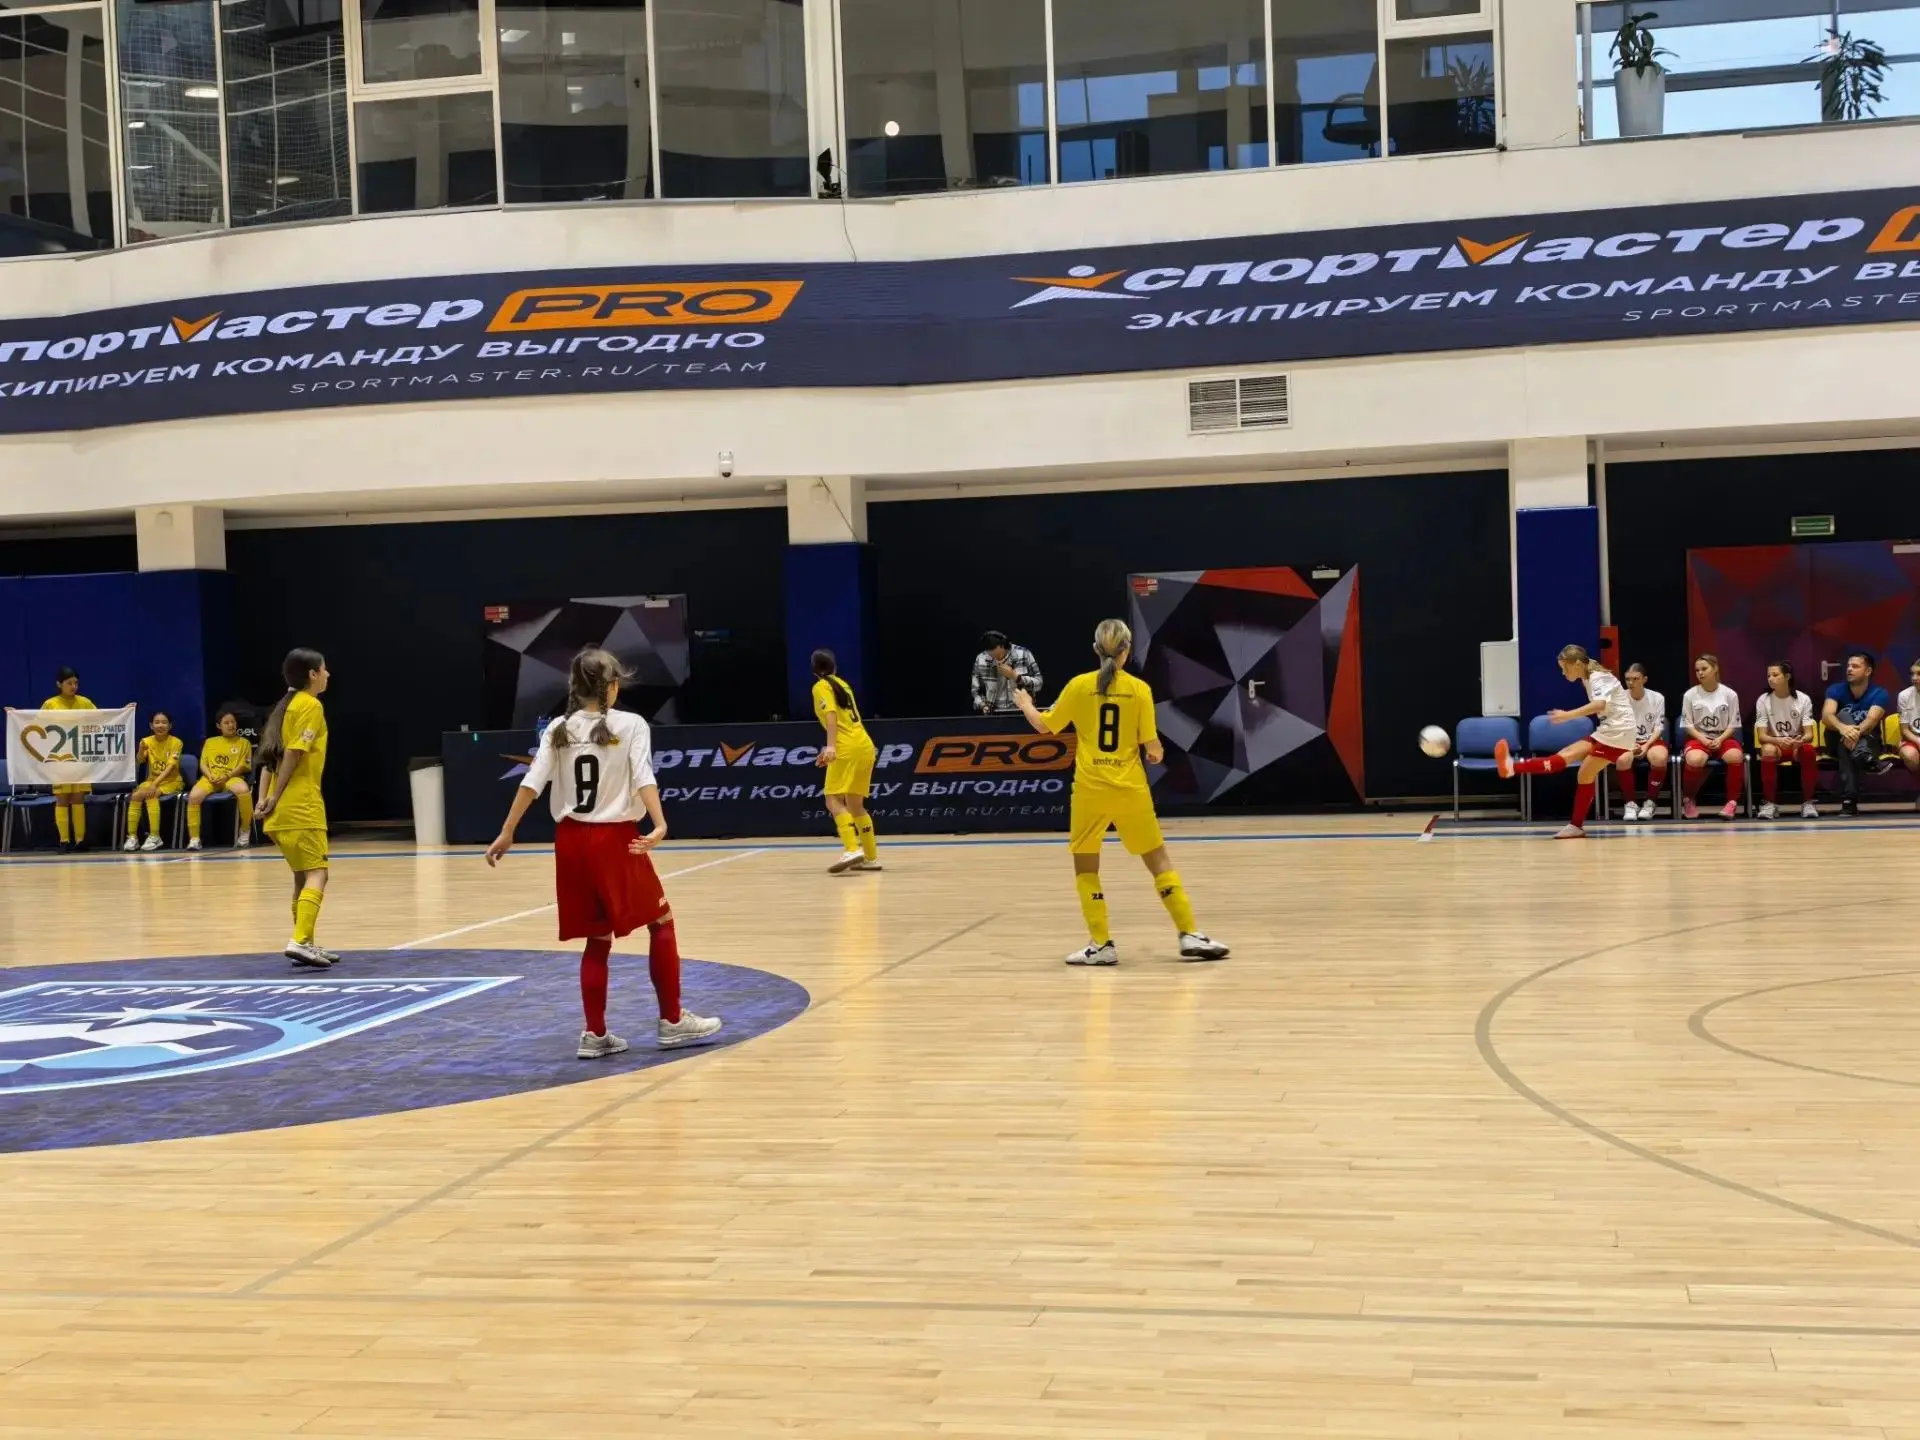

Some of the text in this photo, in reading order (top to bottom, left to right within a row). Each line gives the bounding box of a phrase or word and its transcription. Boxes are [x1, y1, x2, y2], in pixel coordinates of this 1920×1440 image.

[508, 287, 775, 325] PRO
[1125, 288, 1499, 330] ЭКИПИРУЕМ
[1515, 265, 1840, 303] КОМАНДУ
[212, 344, 464, 376] КОМАНДУ
[476, 332, 766, 358] ВЫГОДНО
[290, 361, 768, 394] SPORTMASTER.RU/TEAM
[1098, 703, 1120, 753] 8
[81, 733, 126, 755] ДЕТИ
[926, 739, 1068, 768] PRO
[909, 779, 1064, 797] ВЫГОДНО
[801, 805, 1065, 820] SPMASTER.RU/TEAM
[37, 984, 430, 997] НОРИЛЬСК
